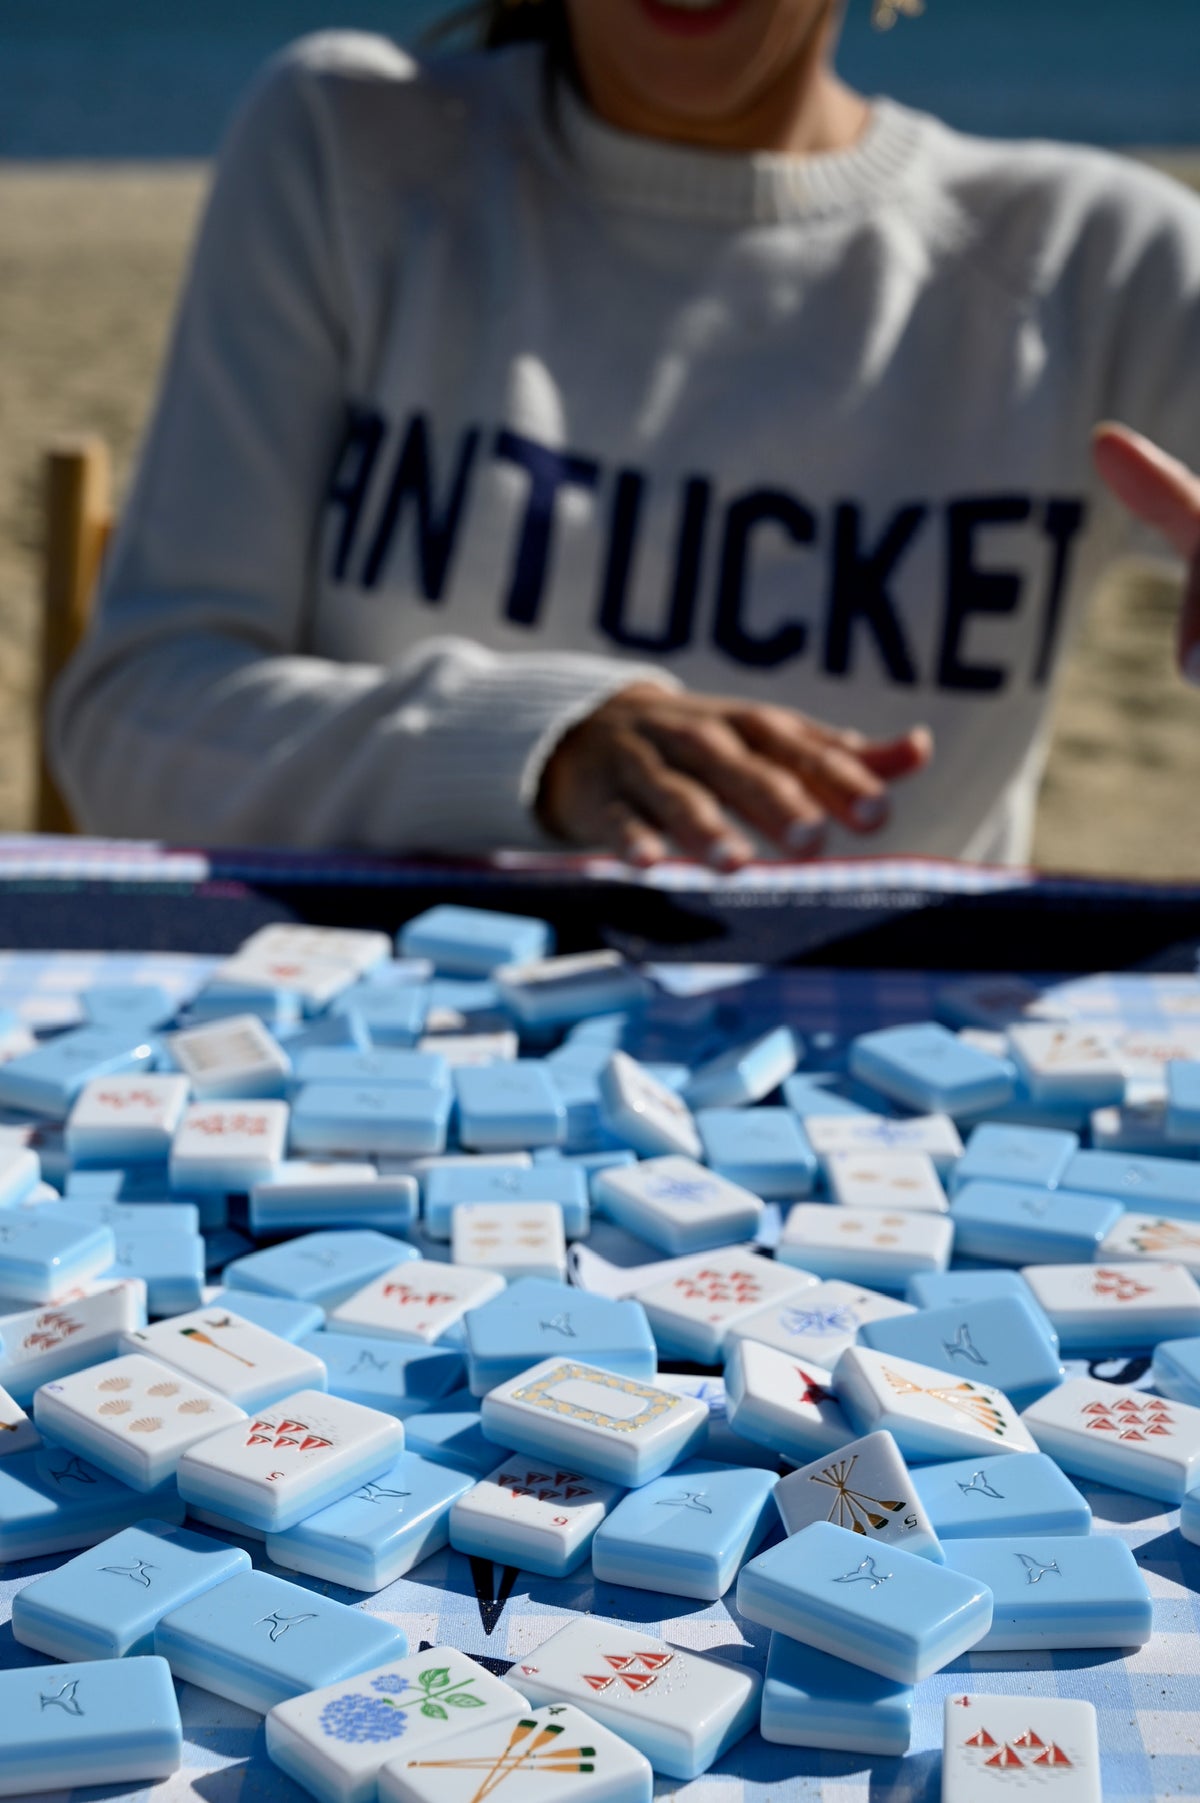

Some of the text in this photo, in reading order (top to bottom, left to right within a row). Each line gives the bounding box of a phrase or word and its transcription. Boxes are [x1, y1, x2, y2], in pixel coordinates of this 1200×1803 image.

[265, 1471, 285, 1482] 5
[904, 1513, 918, 1530] 5
[953, 1695, 972, 1708] 4
